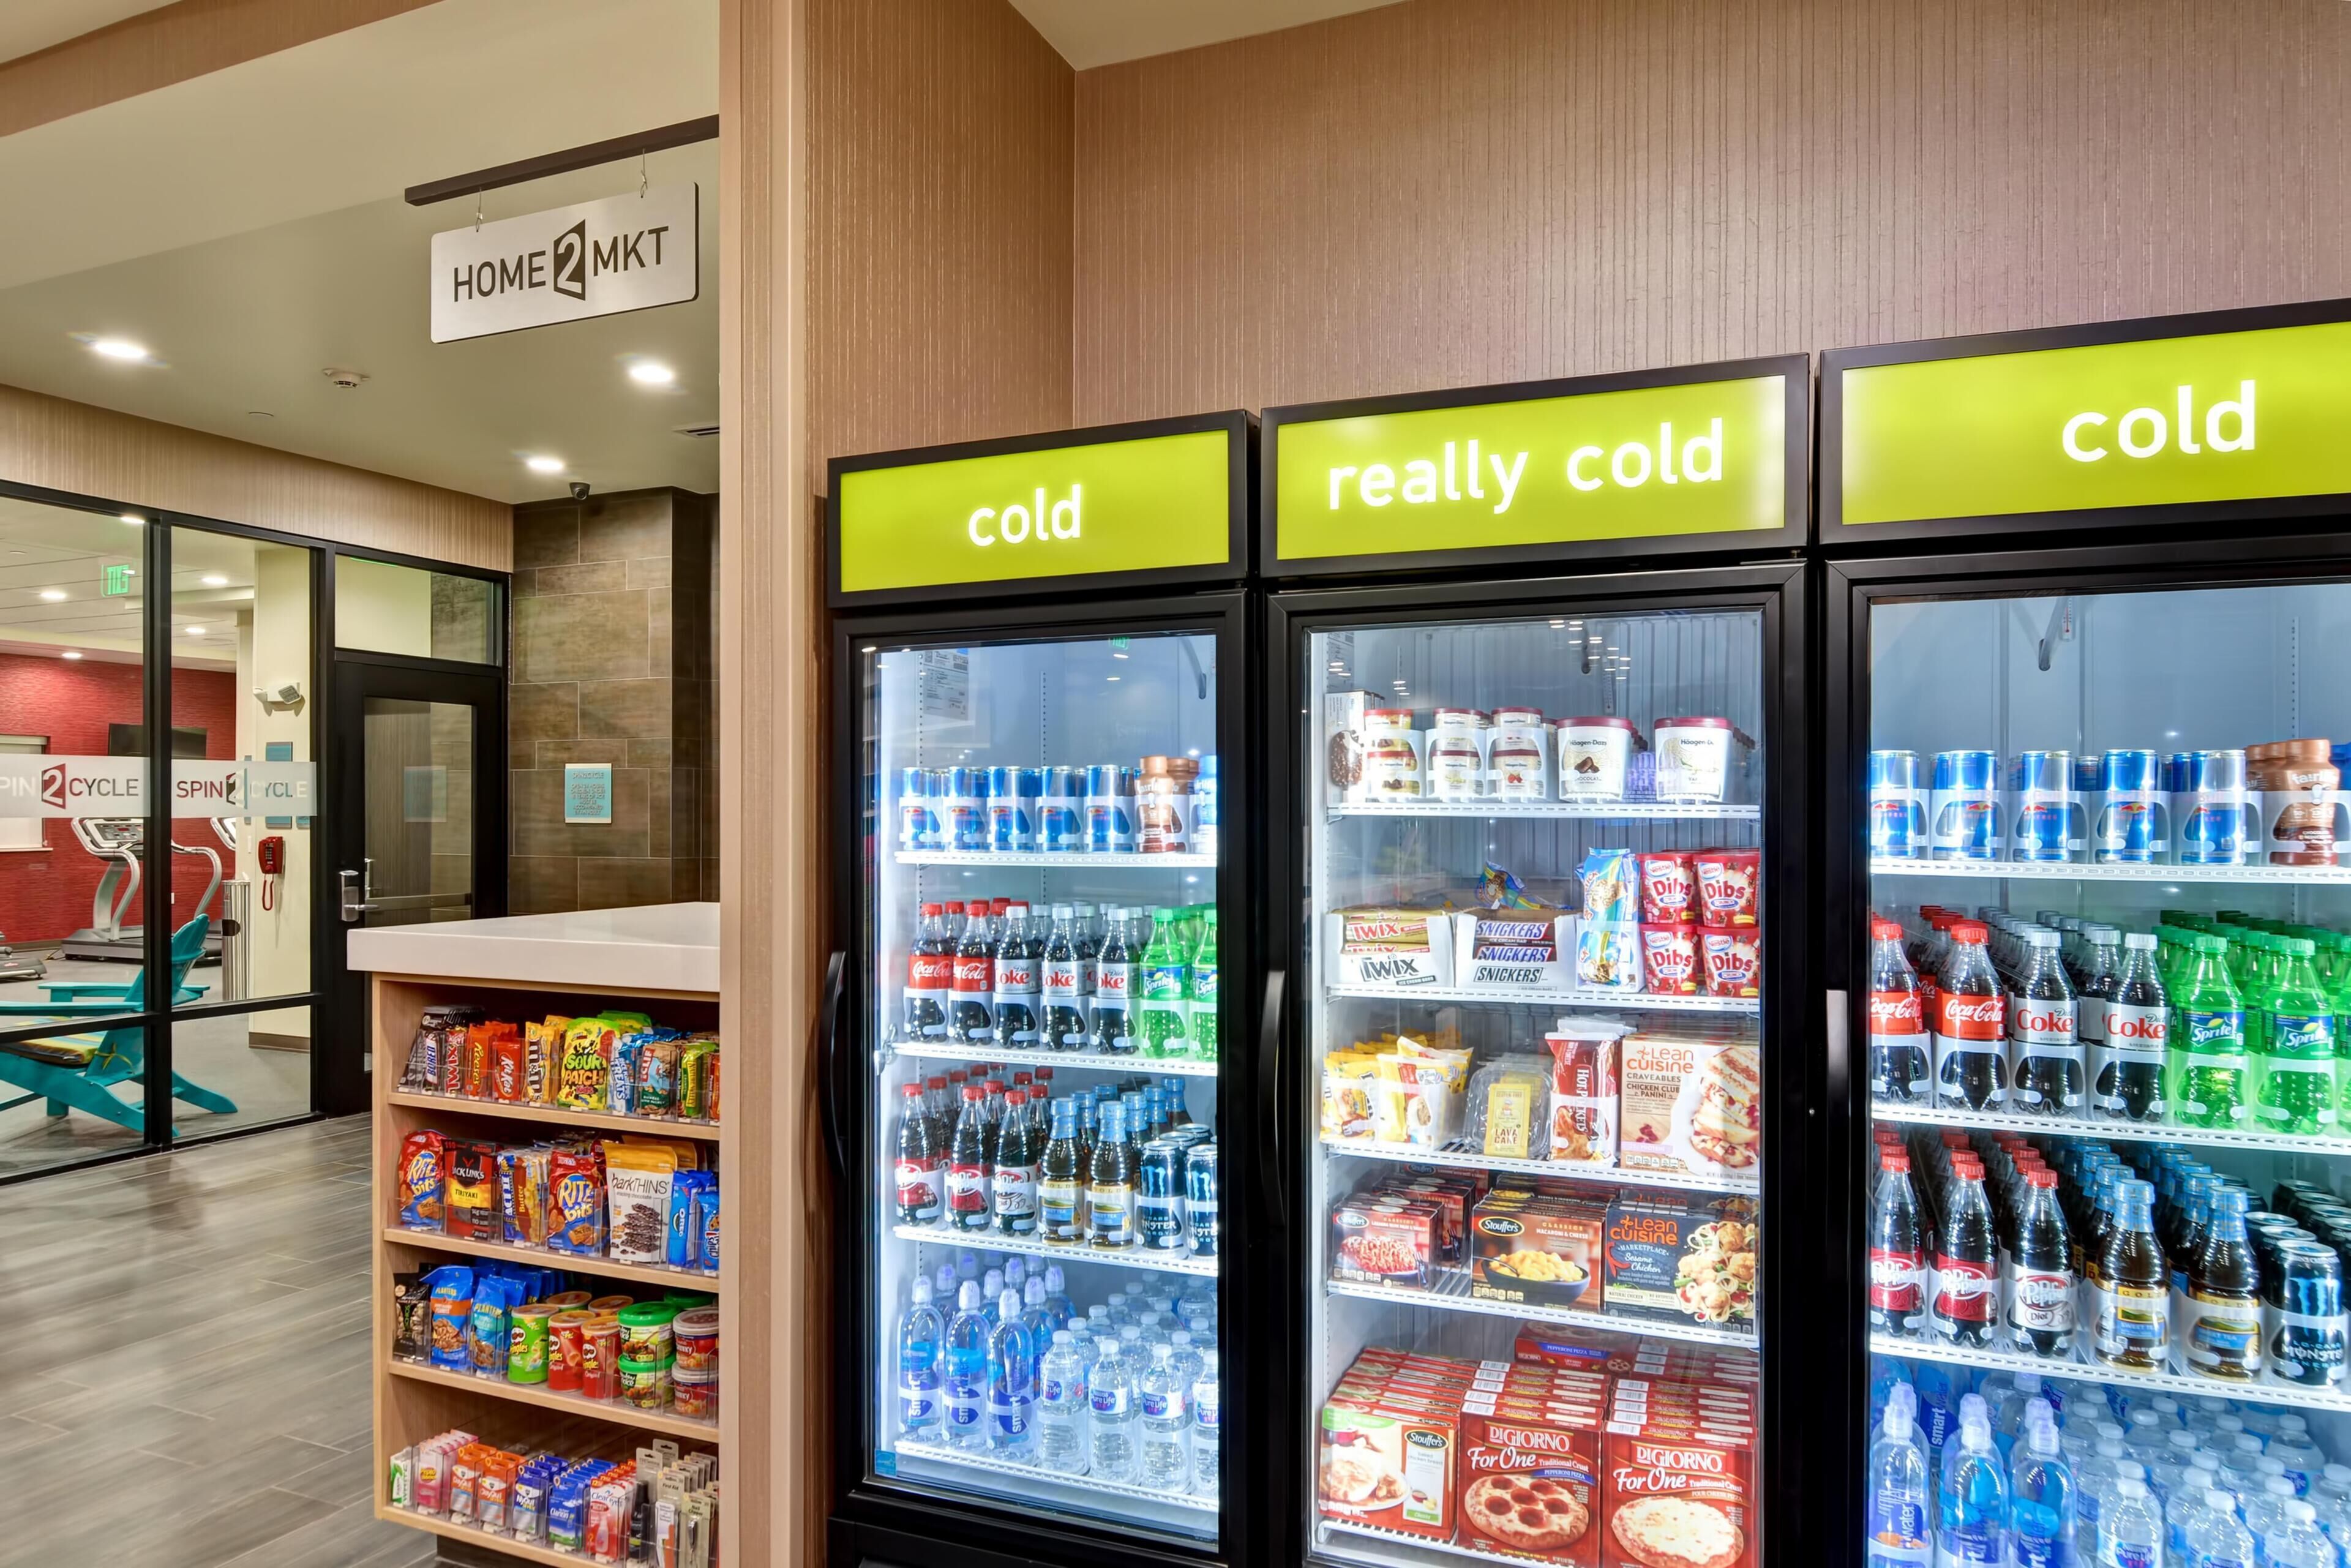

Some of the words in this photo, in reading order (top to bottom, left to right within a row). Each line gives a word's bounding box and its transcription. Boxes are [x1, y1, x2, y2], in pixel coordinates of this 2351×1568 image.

[2063, 380, 2255, 462] cold
[1329, 440, 1529, 514] really
[1567, 418, 1723, 491] cold
[968, 484, 1081, 547] cold
[1652, 877, 1694, 897] Dibs
[1704, 879, 1747, 899] Dibs
[1352, 921, 1401, 941] Twix
[1476, 922, 1545, 939] SNICKERS
[1479, 947, 1549, 963] SNICKERS
[1652, 949, 1693, 968] Dibs
[1711, 952, 1754, 972] Dibs
[1360, 955, 1420, 982] Twix
[1477, 966, 1542, 983] SNICKERS
[2017, 1008, 2074, 1033] Coke
[2107, 1013, 2166, 1040] Coke
[566, 1053, 603, 1070] SOUR
[1651, 1048, 1694, 1062] Lean
[564, 1070, 606, 1086] PATCH
[1577, 1068, 1589, 1086] HOT
[1626, 1072, 1681, 1082] CRAVEABLES
[1626, 1083, 1660, 1092] CHICKEN
[1640, 1090, 1667, 1099] PANINI
[1495, 1128, 1518, 1137] LAVA
[558, 1178, 594, 1208] RITZ
[564, 1202, 594, 1222] bits
[1484, 1220, 1519, 1233] Stouffer's
[1536, 1228, 1564, 1237] MACARONI
[1542, 1222, 1584, 1231] CLASSICS
[1635, 1218, 1678, 1234] Lean
[1621, 1244, 1667, 1256] MARKETPLACE
[1624, 1253, 1654, 1264] Sesame
[1631, 1263, 1661, 1274] Chicken
[1409, 1431, 1443, 1447] Stouffer's
[1468, 1447, 1498, 1470] For
[1499, 1446, 1536, 1470] One
[1539, 1458, 1572, 1468] Traditional
[1572, 1460, 1589, 1472] Crust
[1571, 1471, 1586, 1480] PIZZA
[1613, 1467, 1646, 1492] For
[1646, 1467, 1687, 1491] One
[1689, 1480, 1725, 1488] Traditional
[1725, 1482, 1743, 1493] Crust
